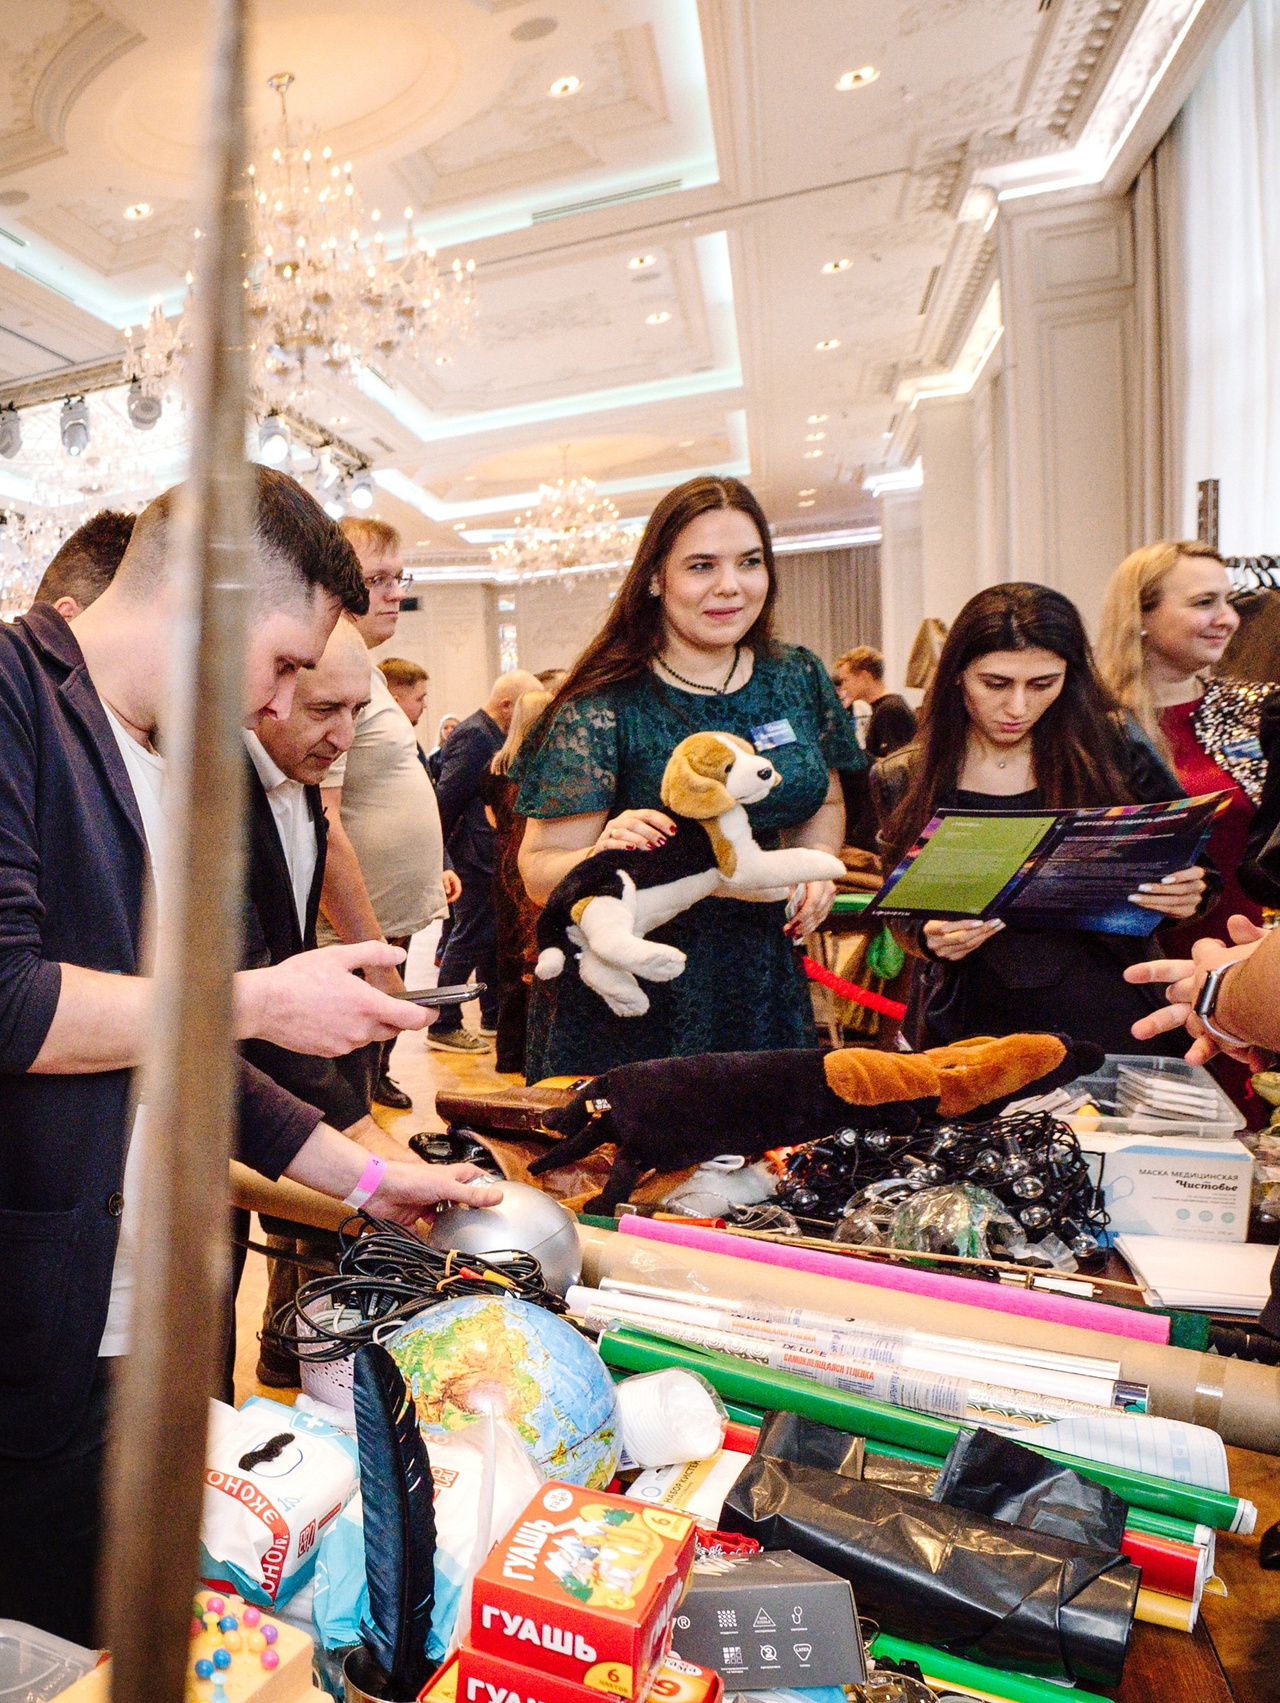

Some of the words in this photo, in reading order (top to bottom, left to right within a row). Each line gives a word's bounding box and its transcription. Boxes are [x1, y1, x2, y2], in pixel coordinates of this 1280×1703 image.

[1139, 1169, 1169, 1177] МАСКА
[1171, 1171, 1239, 1181] МЕДИЦИНСКАЯ
[1176, 1180, 1238, 1192] Чистовье
[781, 1343, 796, 1351] DE
[799, 1347, 827, 1358] LUXE
[783, 1353, 844, 1375] САМОКЛЕЯЩАЯСЯ
[207, 1471, 279, 1525] ЭКОНО
[664, 1482, 682, 1503] НАБОР
[503, 1519, 556, 1581] ГУАШЬ
[482, 1604, 597, 1663] ГУАШЬ
[607, 1669, 620, 1683] 6
